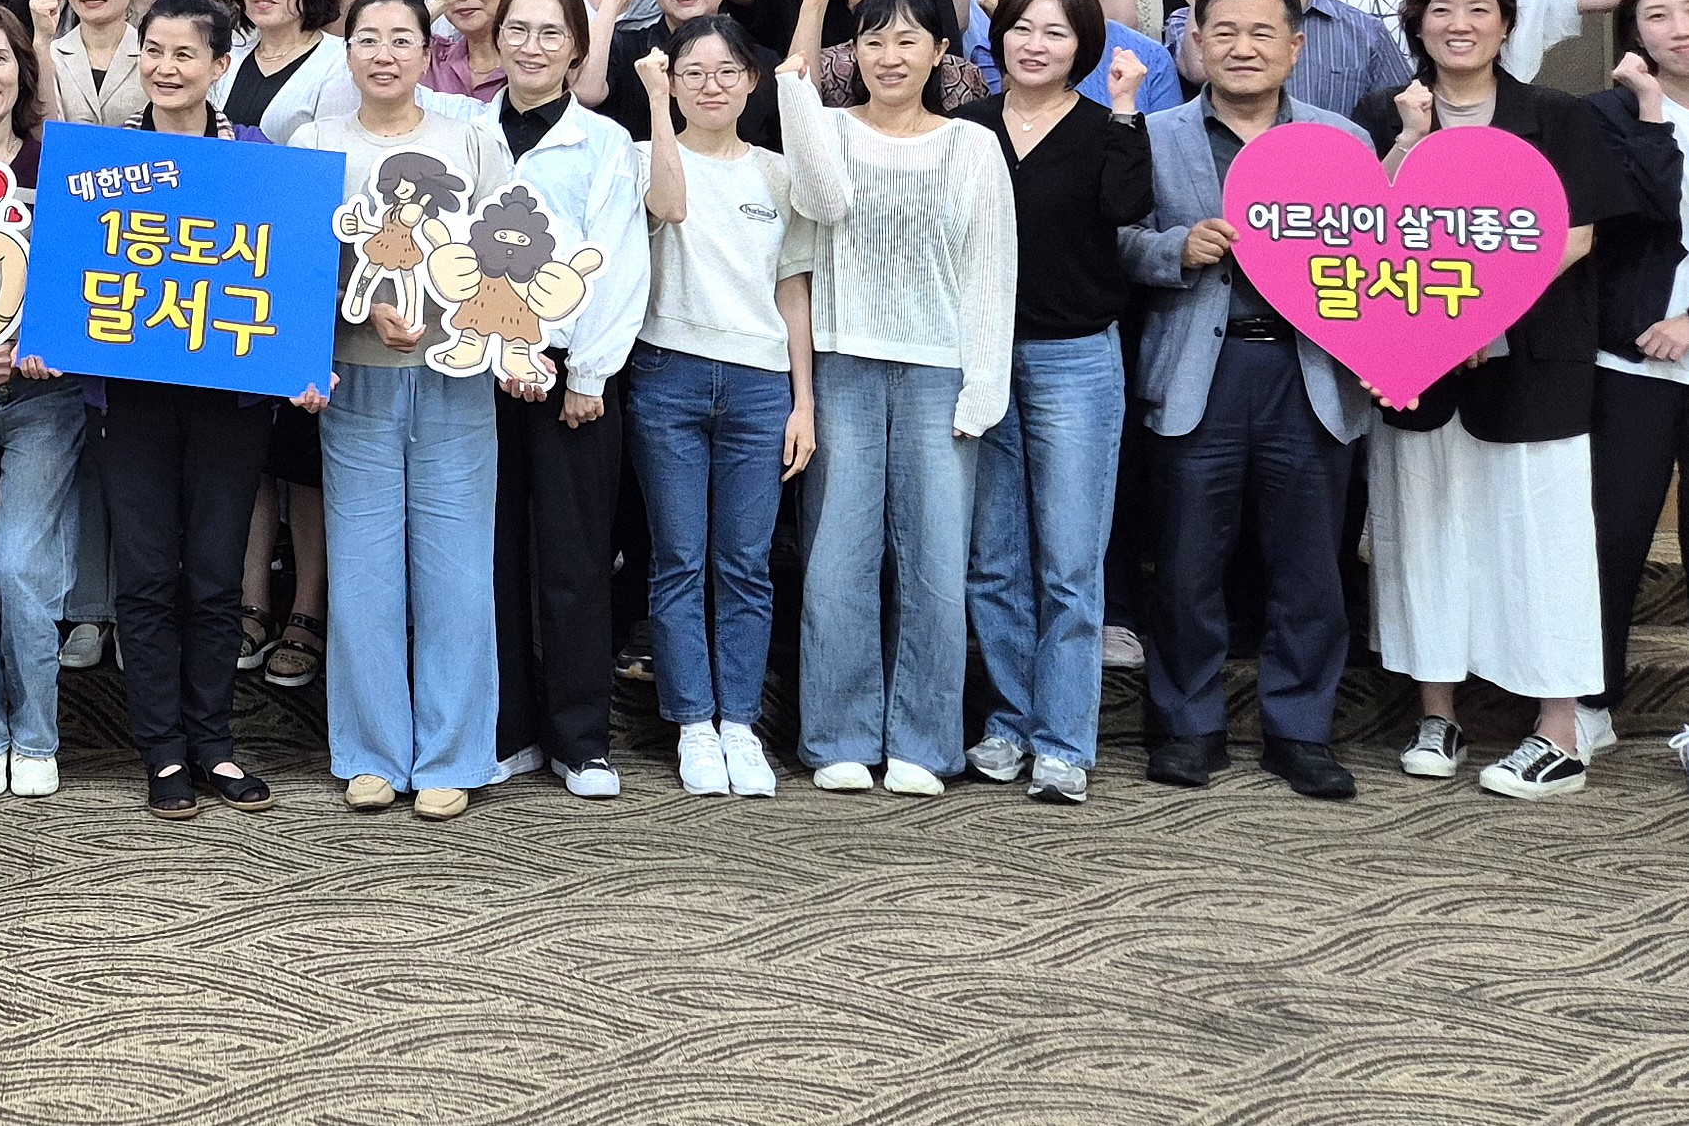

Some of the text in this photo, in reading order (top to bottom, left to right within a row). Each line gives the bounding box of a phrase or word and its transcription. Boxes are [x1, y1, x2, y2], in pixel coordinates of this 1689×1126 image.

[66, 159, 181, 201] 대한민국
[99, 209, 271, 279] 1등도시
[1246, 202, 1542, 251] 어르신이 살기좋은
[82, 270, 278, 357] 달서구
[1309, 255, 1482, 319] 달서구
